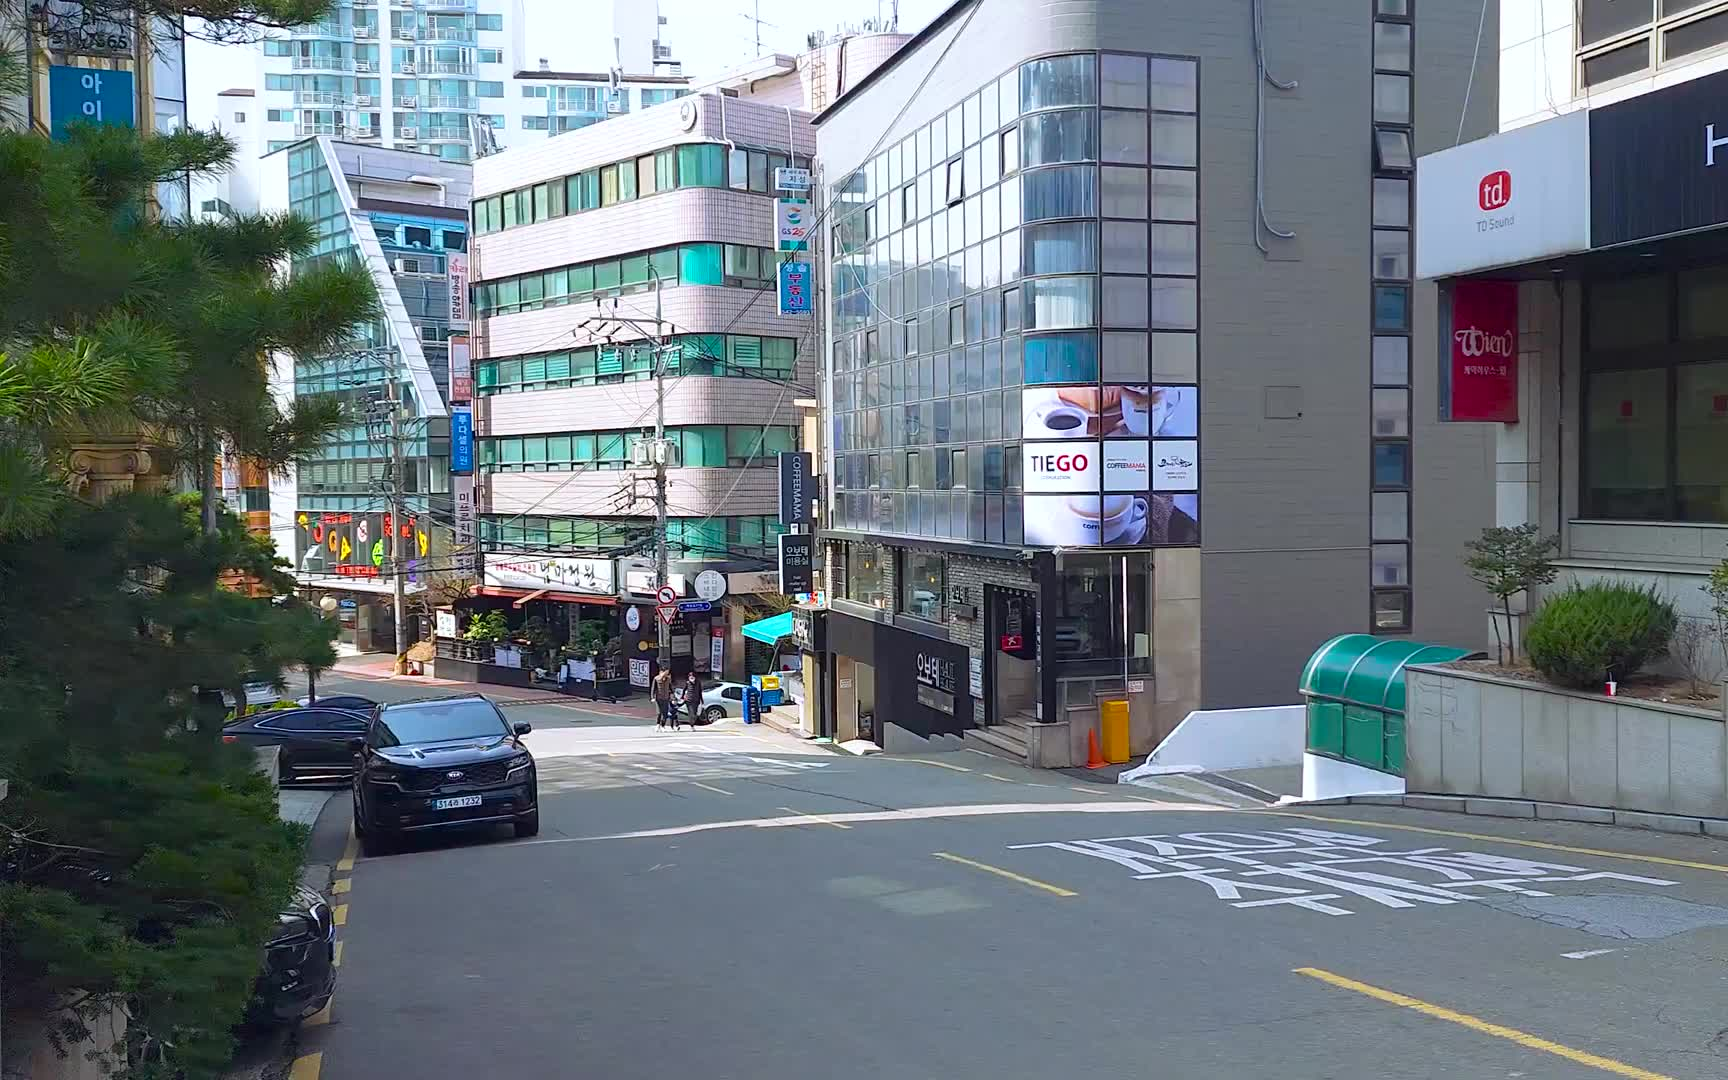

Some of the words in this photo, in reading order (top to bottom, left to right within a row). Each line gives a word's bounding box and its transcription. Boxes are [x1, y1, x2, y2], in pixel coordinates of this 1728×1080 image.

[1476, 220, 1487, 232] TD
[1489, 216, 1514, 230] Sound
[787, 273, 804, 308] 부동산
[1031, 454, 1088, 472] TIEGO
[792, 456, 802, 520] COFFEEMAMA
[786, 557, 809, 566] 미용실
[1132, 850, 1681, 916] 주차구역
